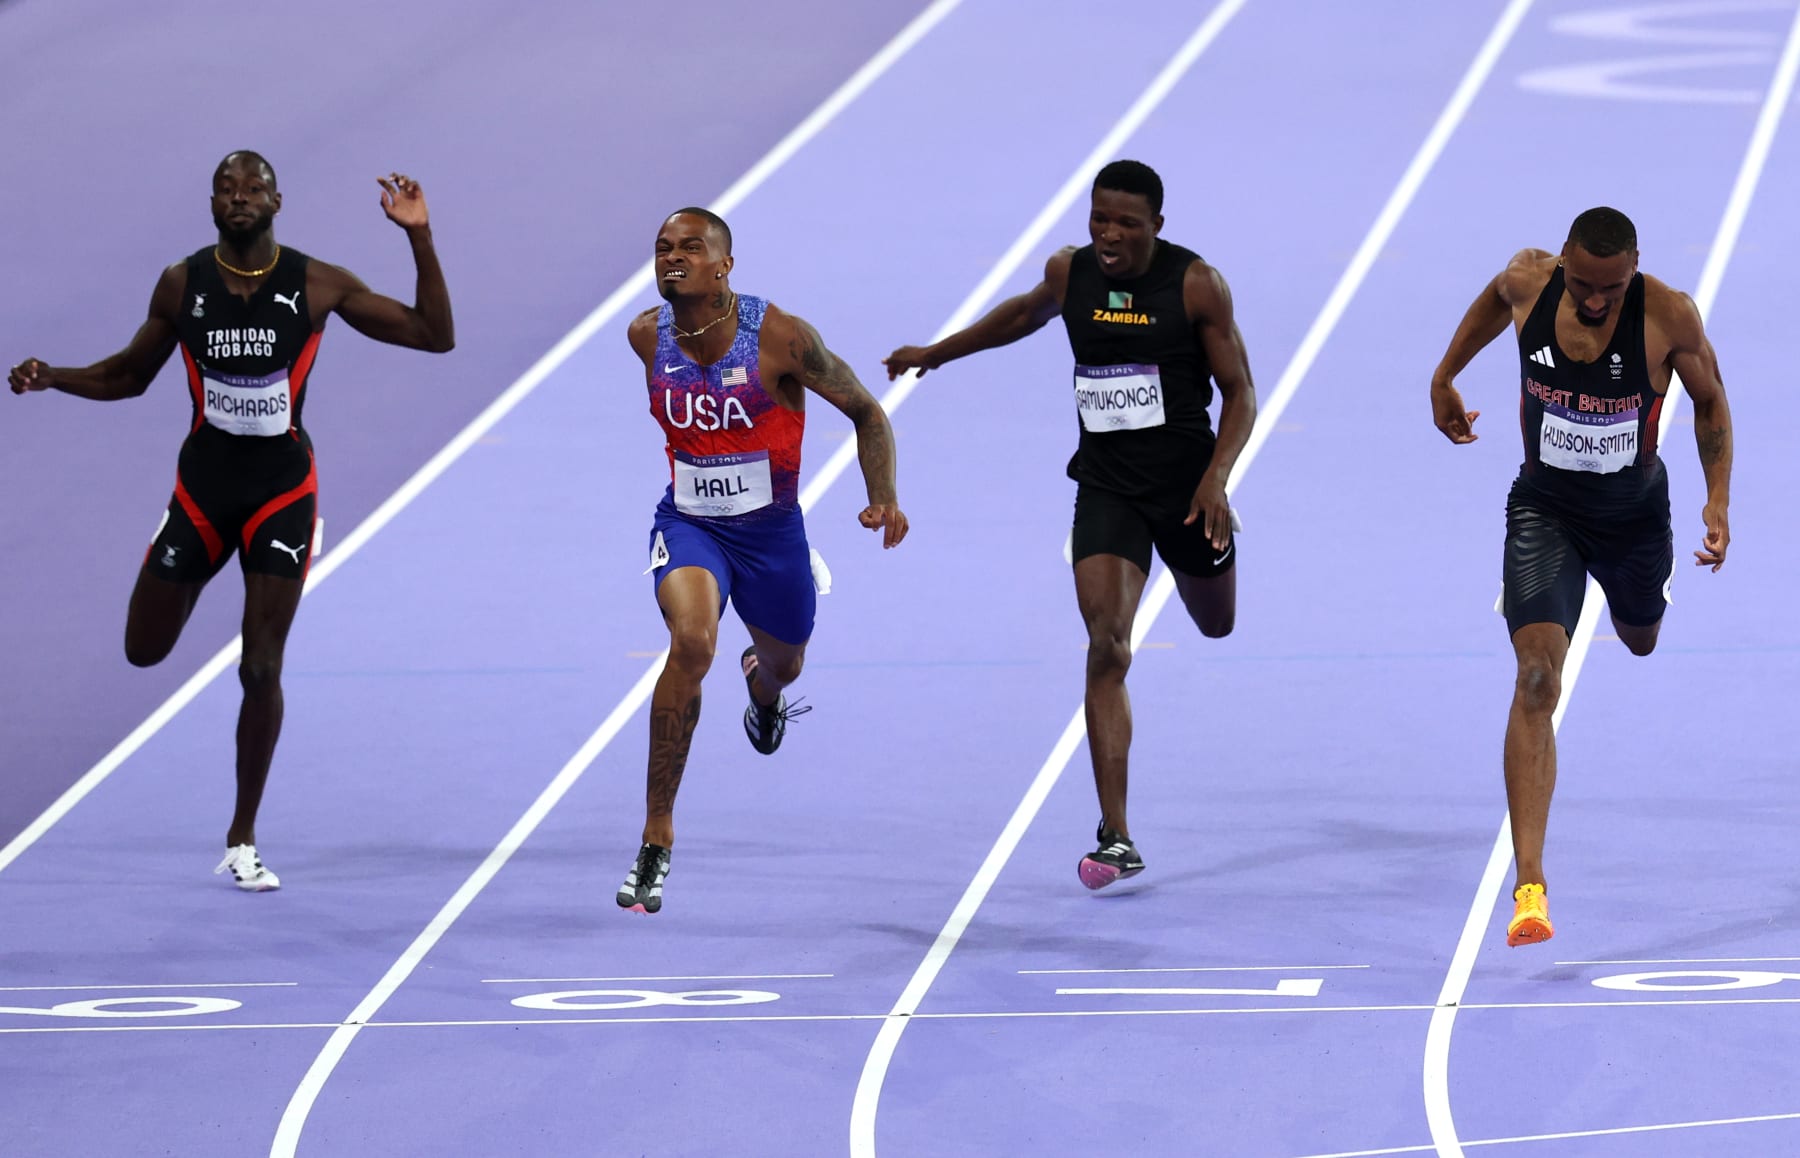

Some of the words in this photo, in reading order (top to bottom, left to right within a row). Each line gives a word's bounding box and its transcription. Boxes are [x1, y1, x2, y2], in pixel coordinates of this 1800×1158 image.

[1092, 309, 1149, 325] ZAMBIA
[206, 328, 276, 345] TRINIDAD
[1111, 367, 1133, 375] 2024
[207, 389, 287, 418] RICHARDS
[1077, 385, 1159, 410] SAMUKONGA
[1526, 377, 1573, 408] GREAT
[1578, 392, 1643, 413] BRITAIN
[665, 388, 753, 431] USA
[1566, 411, 1590, 423] PARIS
[1592, 416, 1615, 424] 2024
[1543, 424, 1635, 455] HUDSON-SMITH
[692, 457, 716, 465] PARIS
[718, 456, 743, 464] 2024
[694, 475, 750, 498] HALL
[510, 989, 781, 1011] 8
